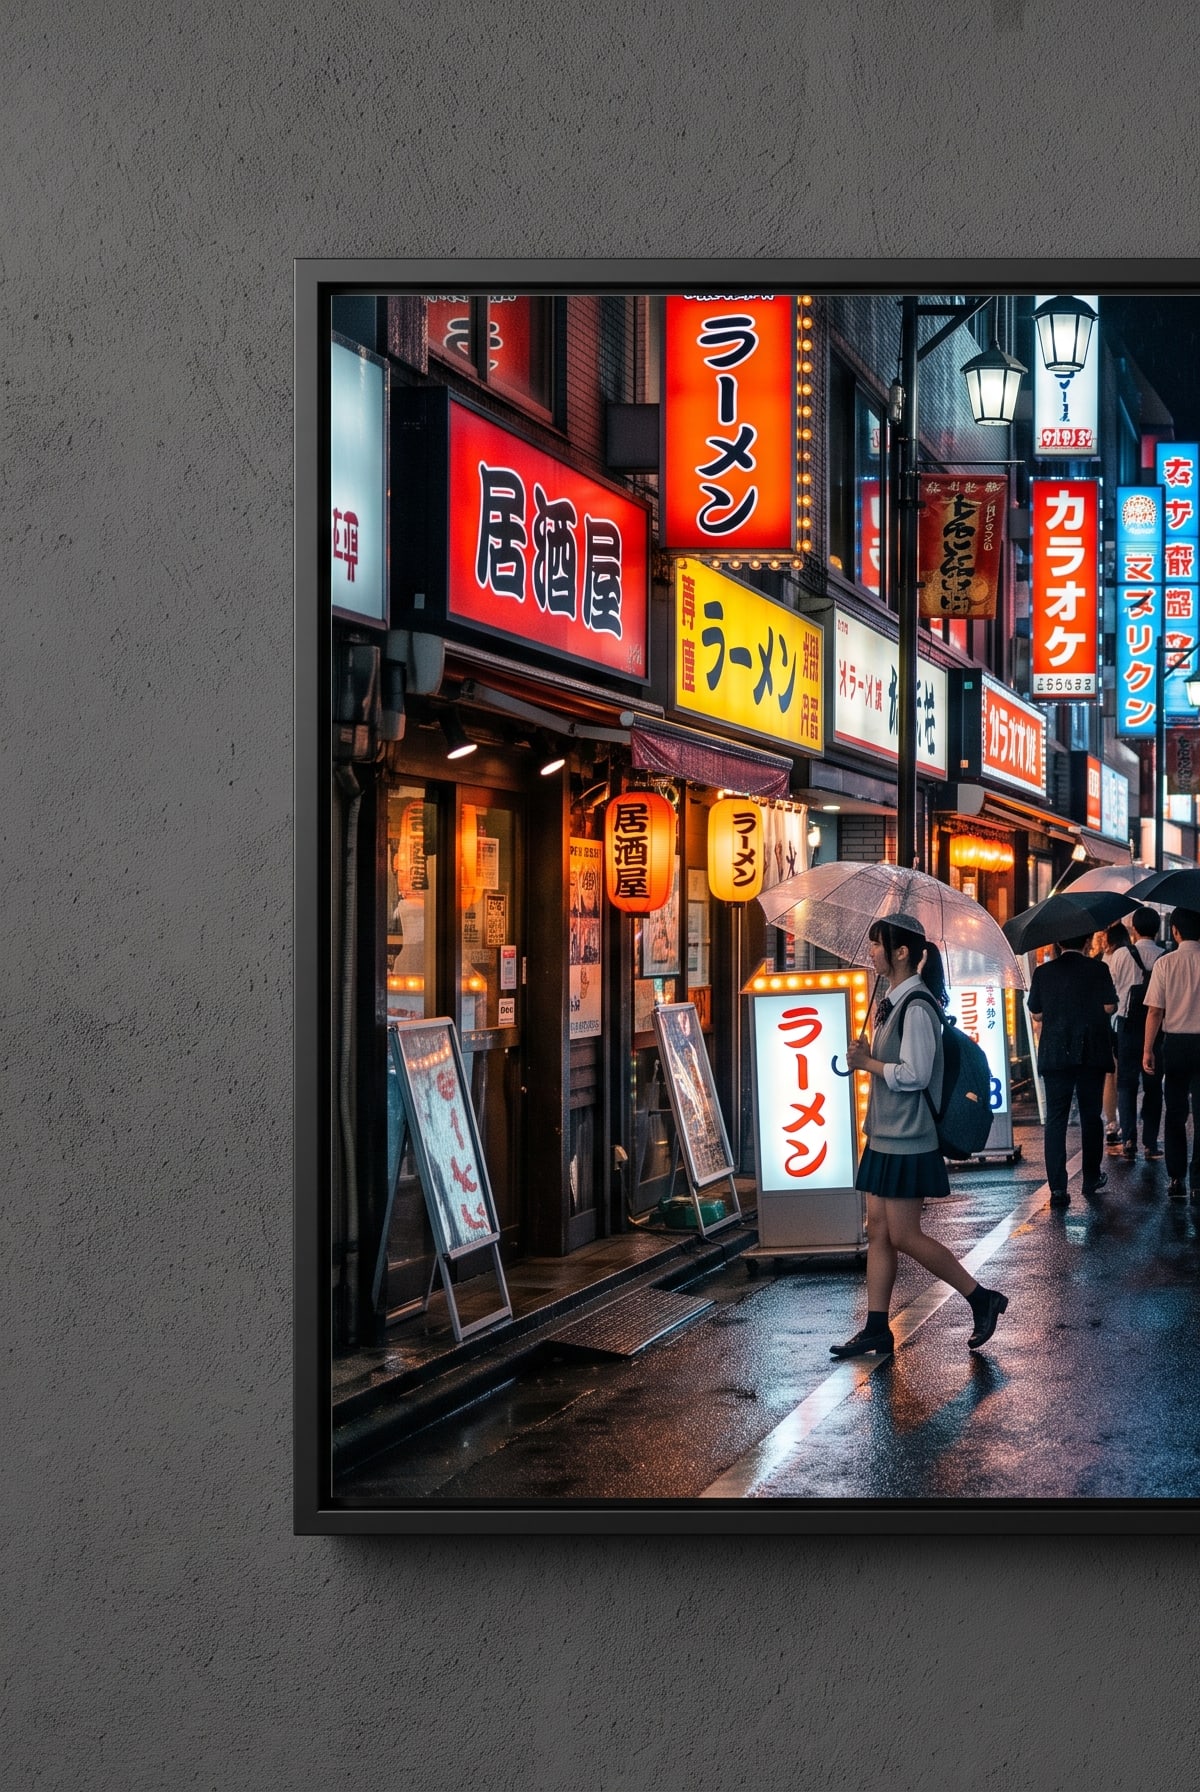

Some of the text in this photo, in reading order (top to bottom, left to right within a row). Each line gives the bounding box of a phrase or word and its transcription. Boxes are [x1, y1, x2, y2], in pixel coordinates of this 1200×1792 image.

[697, 314, 758, 537] ラーメン
[475, 460, 624, 641] 居酒屋
[1044, 489, 1087, 667] カラオケ
[701, 600, 797, 714] ラーメン
[614, 802, 651, 899] 居酒屋
[732, 812, 757, 887] ラーメン
[777, 1006, 828, 1178] ラーメン
